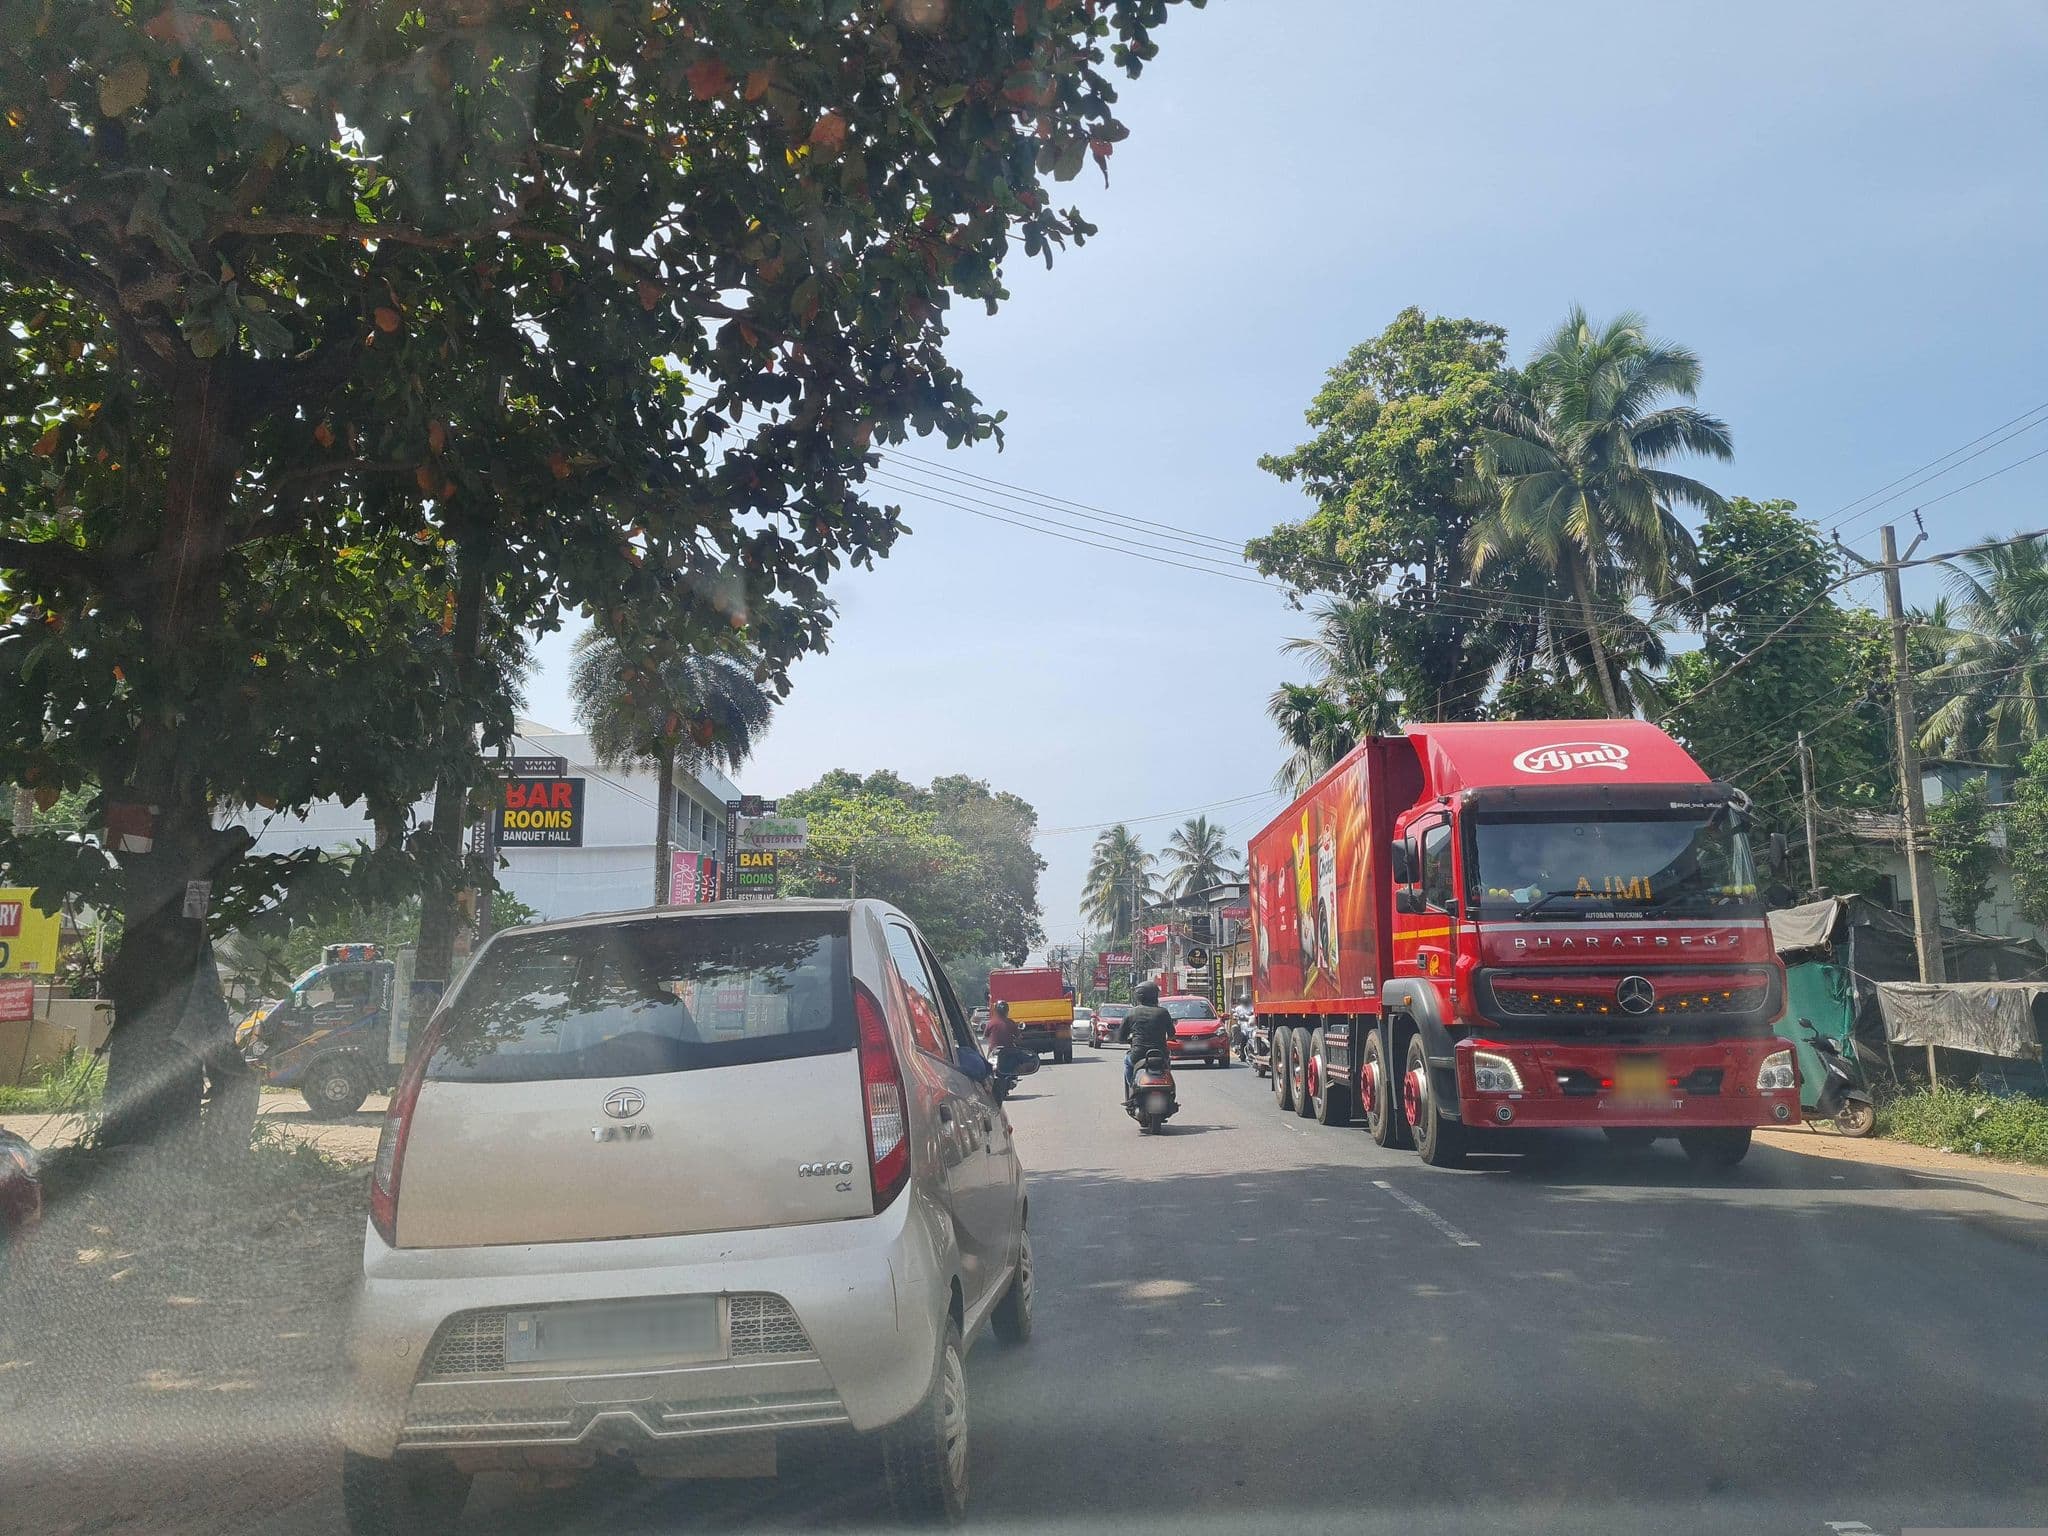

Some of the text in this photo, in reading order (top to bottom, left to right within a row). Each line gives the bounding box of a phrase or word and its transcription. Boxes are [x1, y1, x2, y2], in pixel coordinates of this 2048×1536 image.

[1526, 745, 1622, 771] Ajmi
[506, 782, 573, 809] BAR
[503, 810, 573, 829] ROOMS
[502, 831, 571, 841] BANQUET HALL
[740, 853, 775, 867] BAR
[739, 873, 774, 886] ROOMS
[1574, 876, 1652, 899] AJMI
[1515, 936, 1739, 949] BHARATBENZ
[798, 1161, 852, 1177] nano
